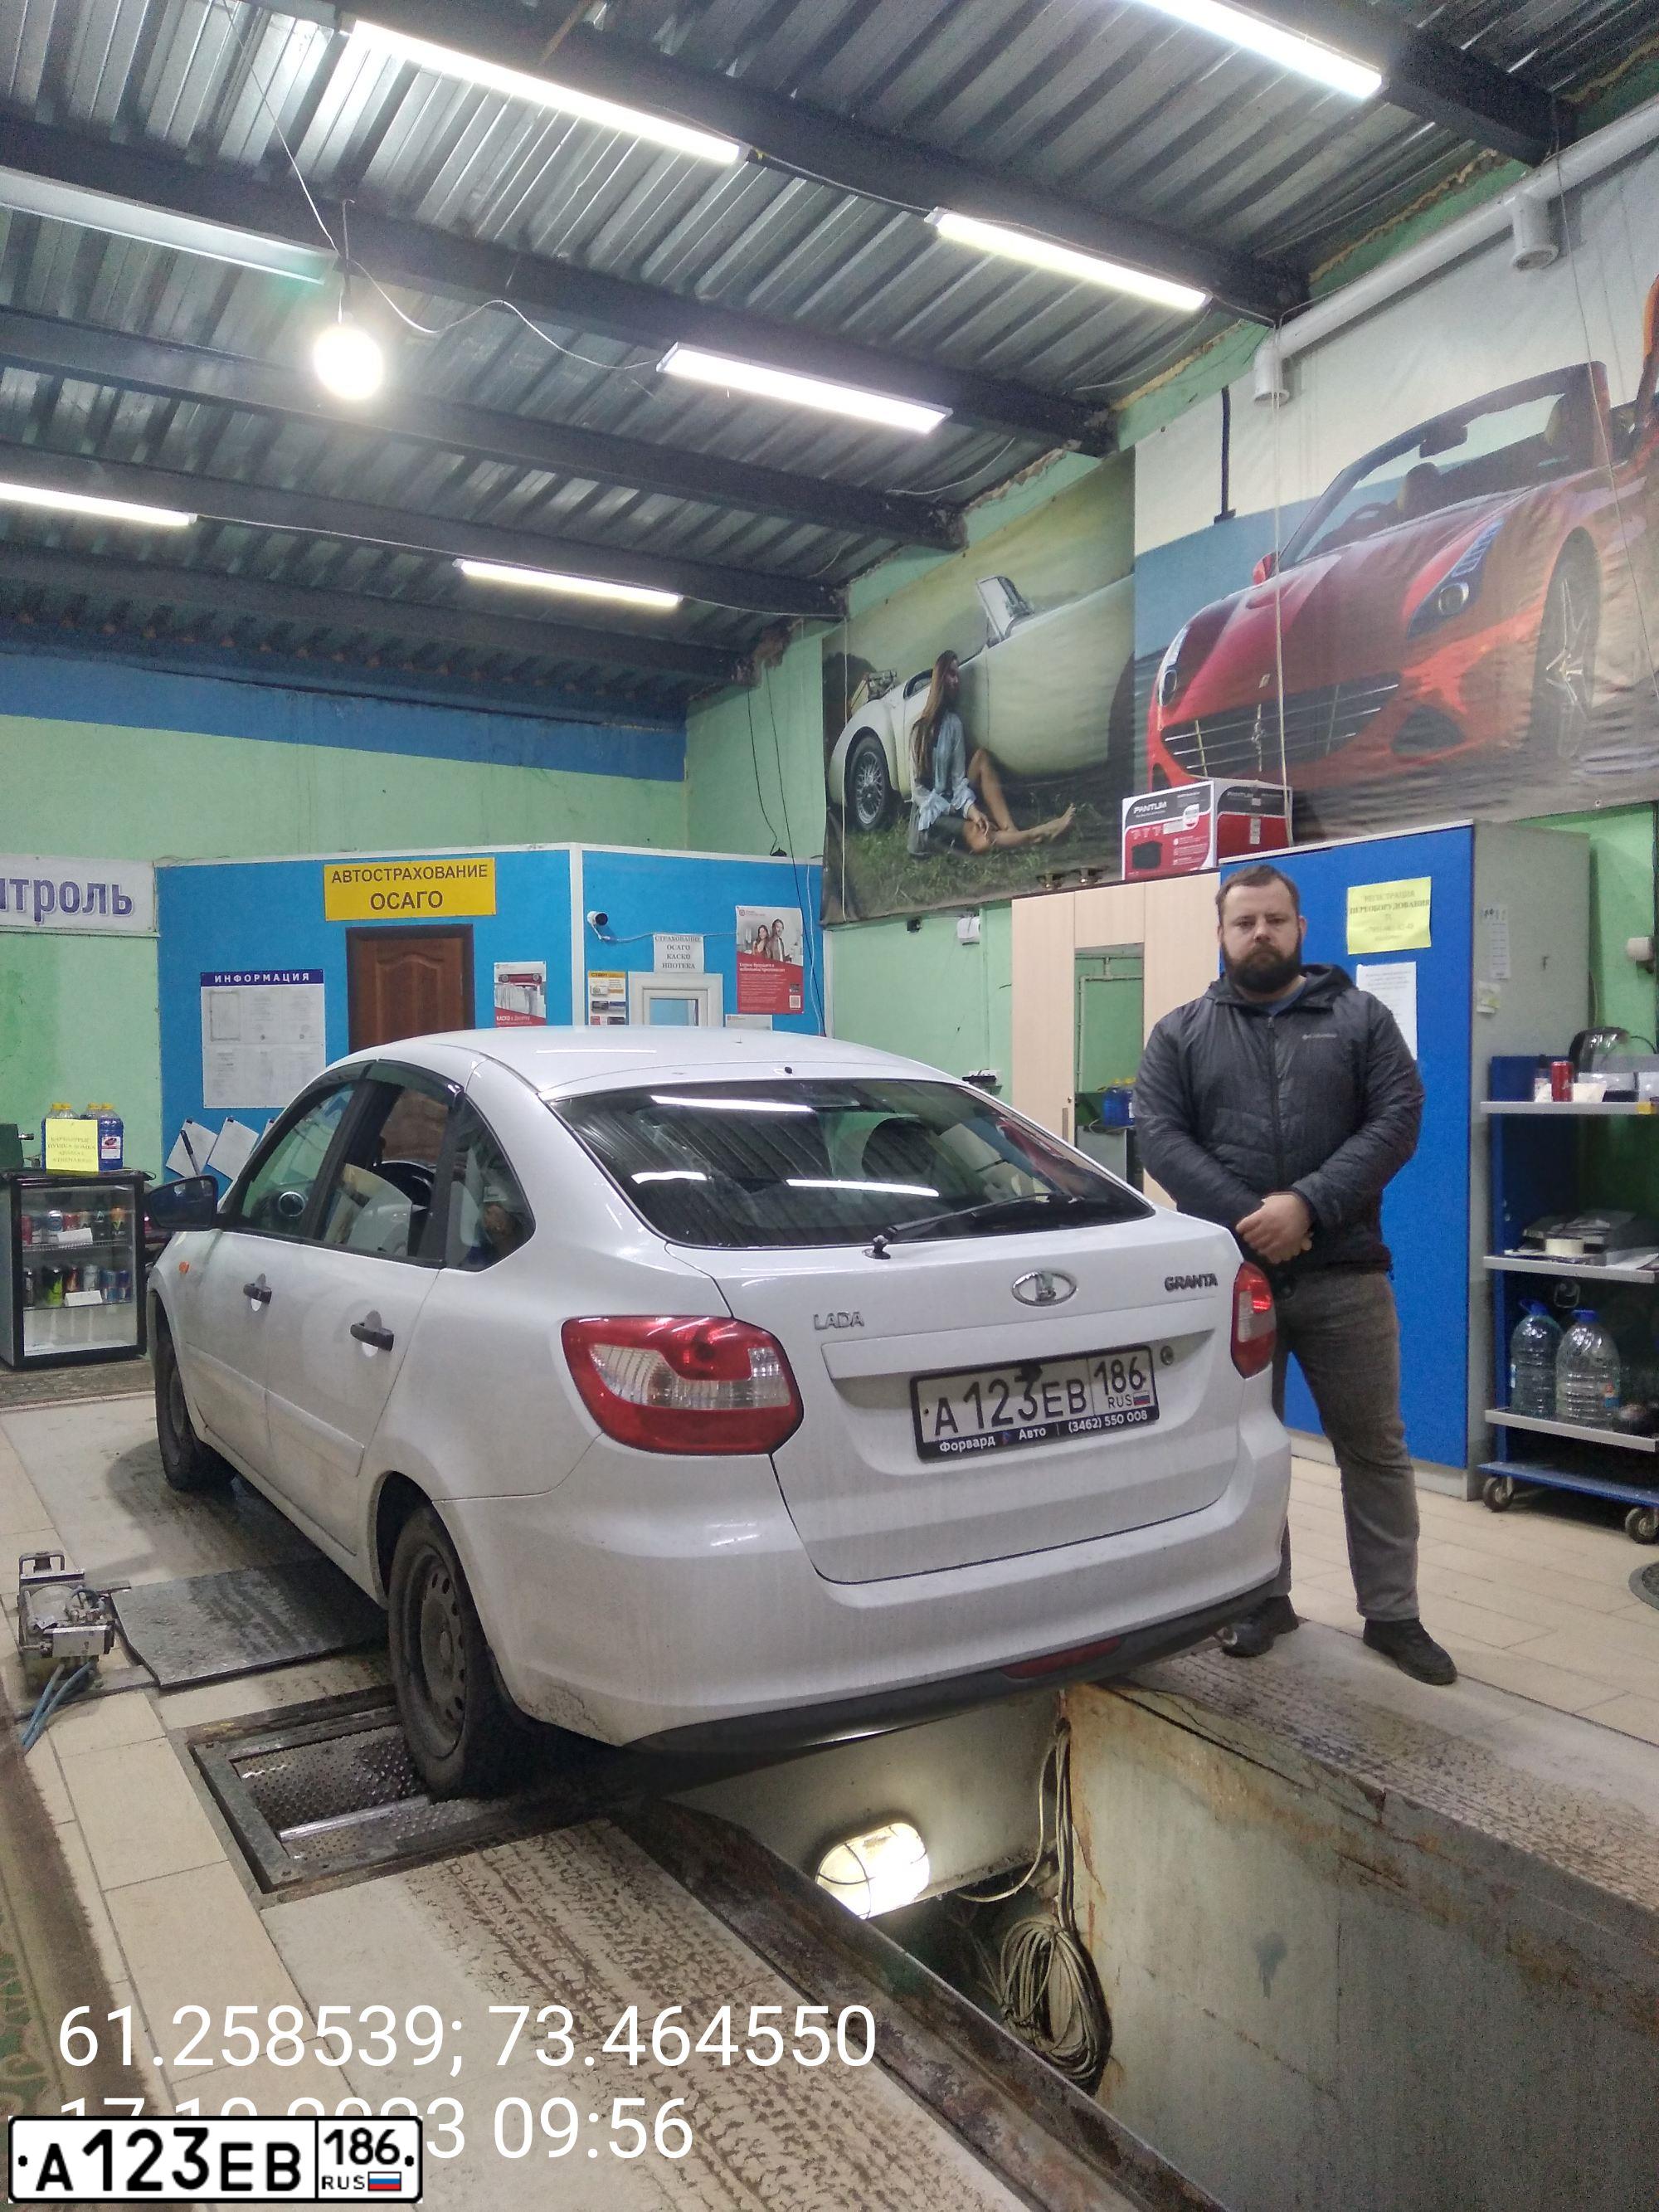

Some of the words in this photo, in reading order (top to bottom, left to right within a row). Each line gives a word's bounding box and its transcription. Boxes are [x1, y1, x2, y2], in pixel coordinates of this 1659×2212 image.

[1133, 801, 1168, 814] PANTUM
[332, 864, 488, 884] АВТОСТРАХОВАНИЕ
[370, 890, 444, 911] ОСАГО
[214, 972, 310, 983] ИНФОРМАЦИЯ
[1164, 1273, 1219, 1292] GRANTA
[813, 1311, 865, 1331] LADA
[1093, 1356, 1145, 1396] 186
[1107, 1394, 1133, 1409] RUS
[939, 1434, 996, 1453] Форвард
[1019, 1428, 1047, 1440] Авто
[1068, 1417, 1102, 1434] (3462)
[1104, 1414, 1124, 1426] 550
[1126, 1410, 1148, 1423] 008
